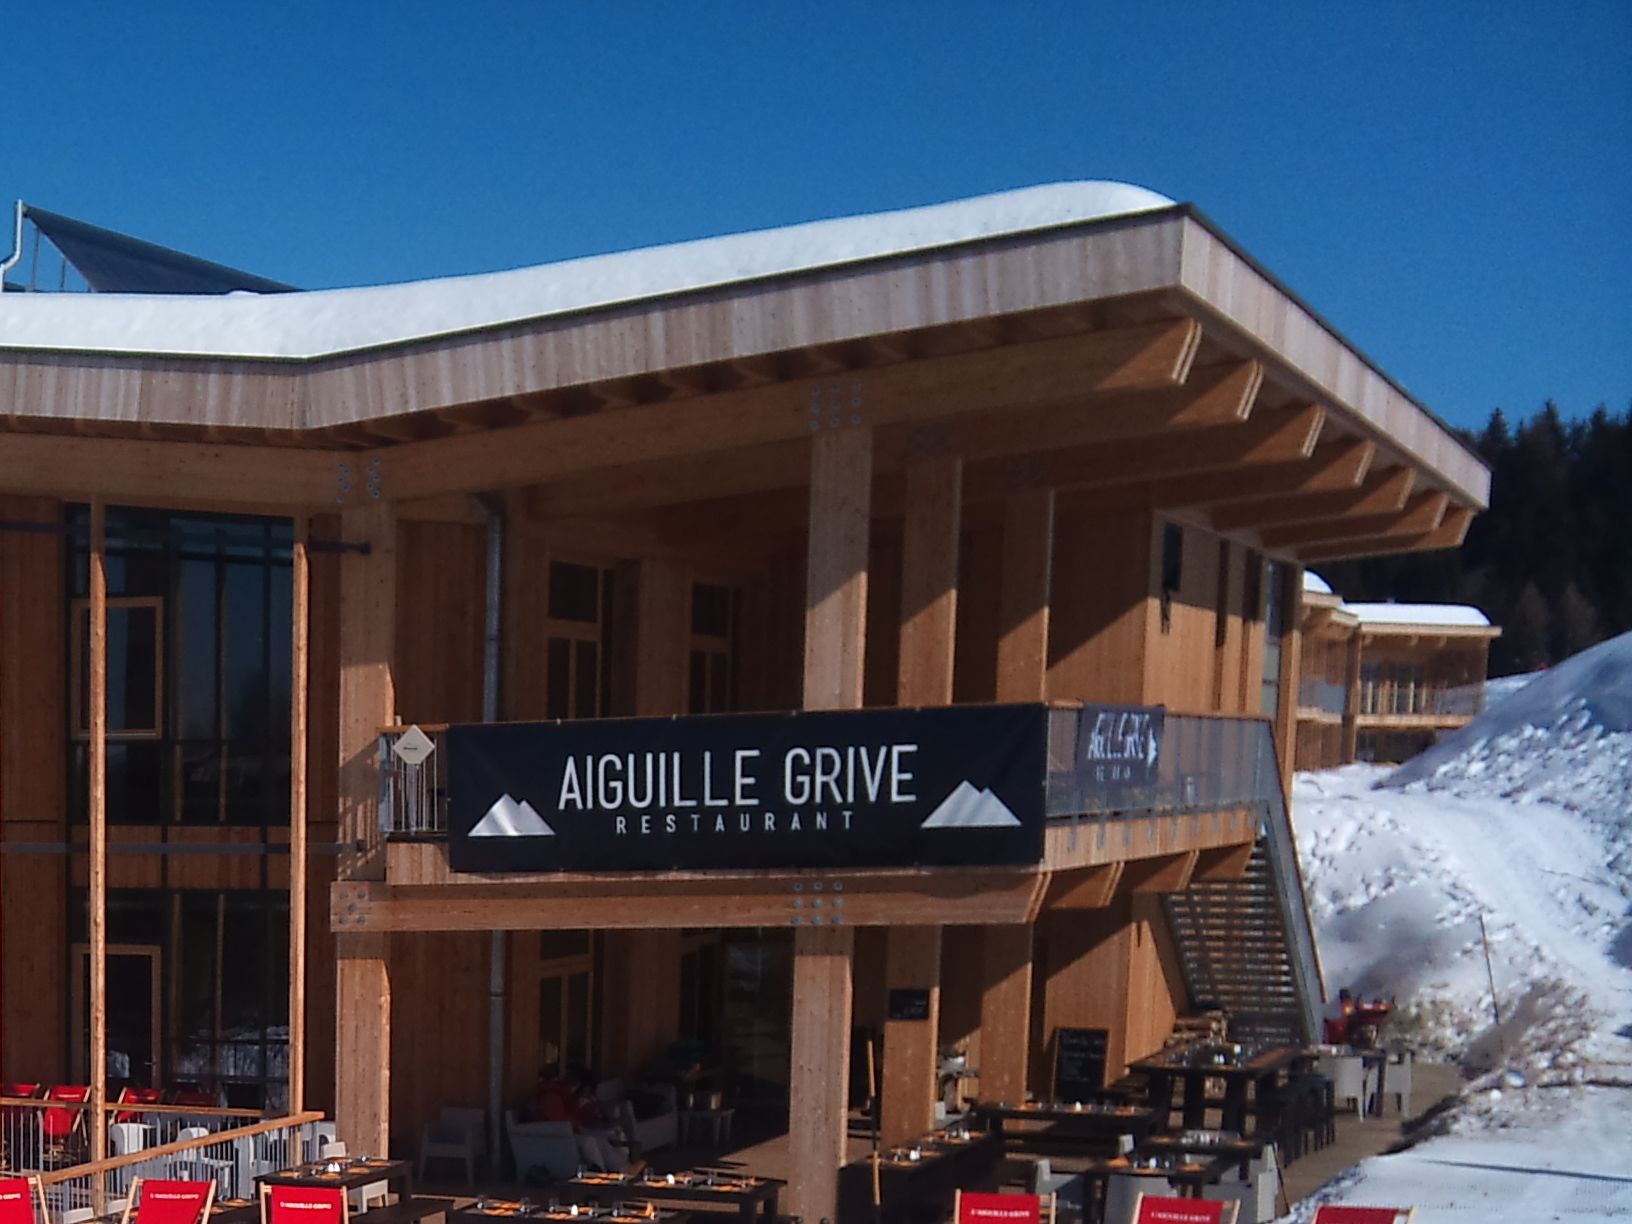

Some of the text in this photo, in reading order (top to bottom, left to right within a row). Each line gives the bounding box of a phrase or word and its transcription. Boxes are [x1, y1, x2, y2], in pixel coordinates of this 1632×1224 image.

[558, 744, 918, 810] AIGUILLE GRIVE
[615, 811, 853, 835] RESTAURANT
